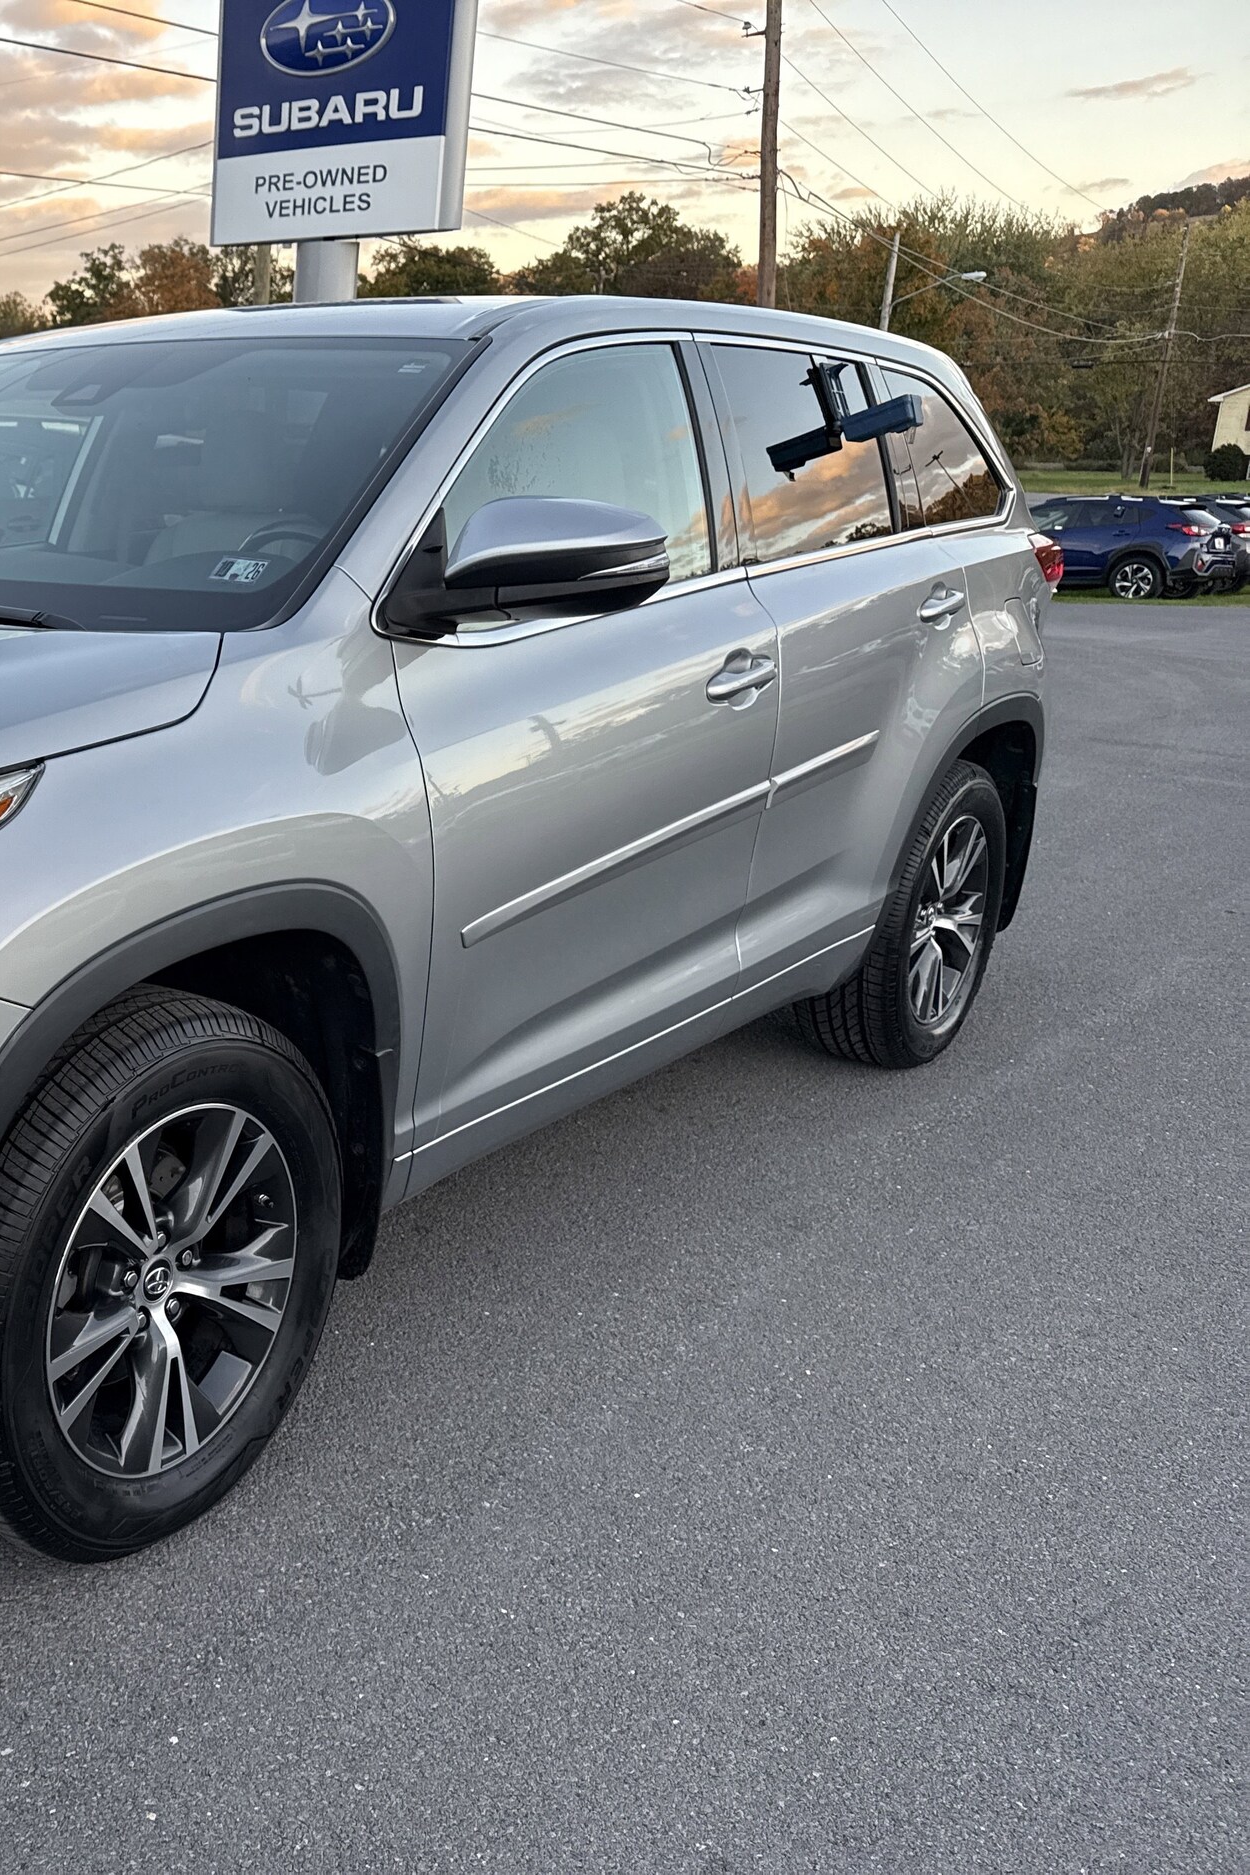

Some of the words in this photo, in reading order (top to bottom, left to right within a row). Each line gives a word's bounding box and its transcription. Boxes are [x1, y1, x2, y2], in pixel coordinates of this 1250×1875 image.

[233, 85, 424, 138] SUBARU
[255, 164, 388, 194] PRE-OWNED
[265, 193, 371, 218] VEHICLES
[244, 562, 266, 580] 26
